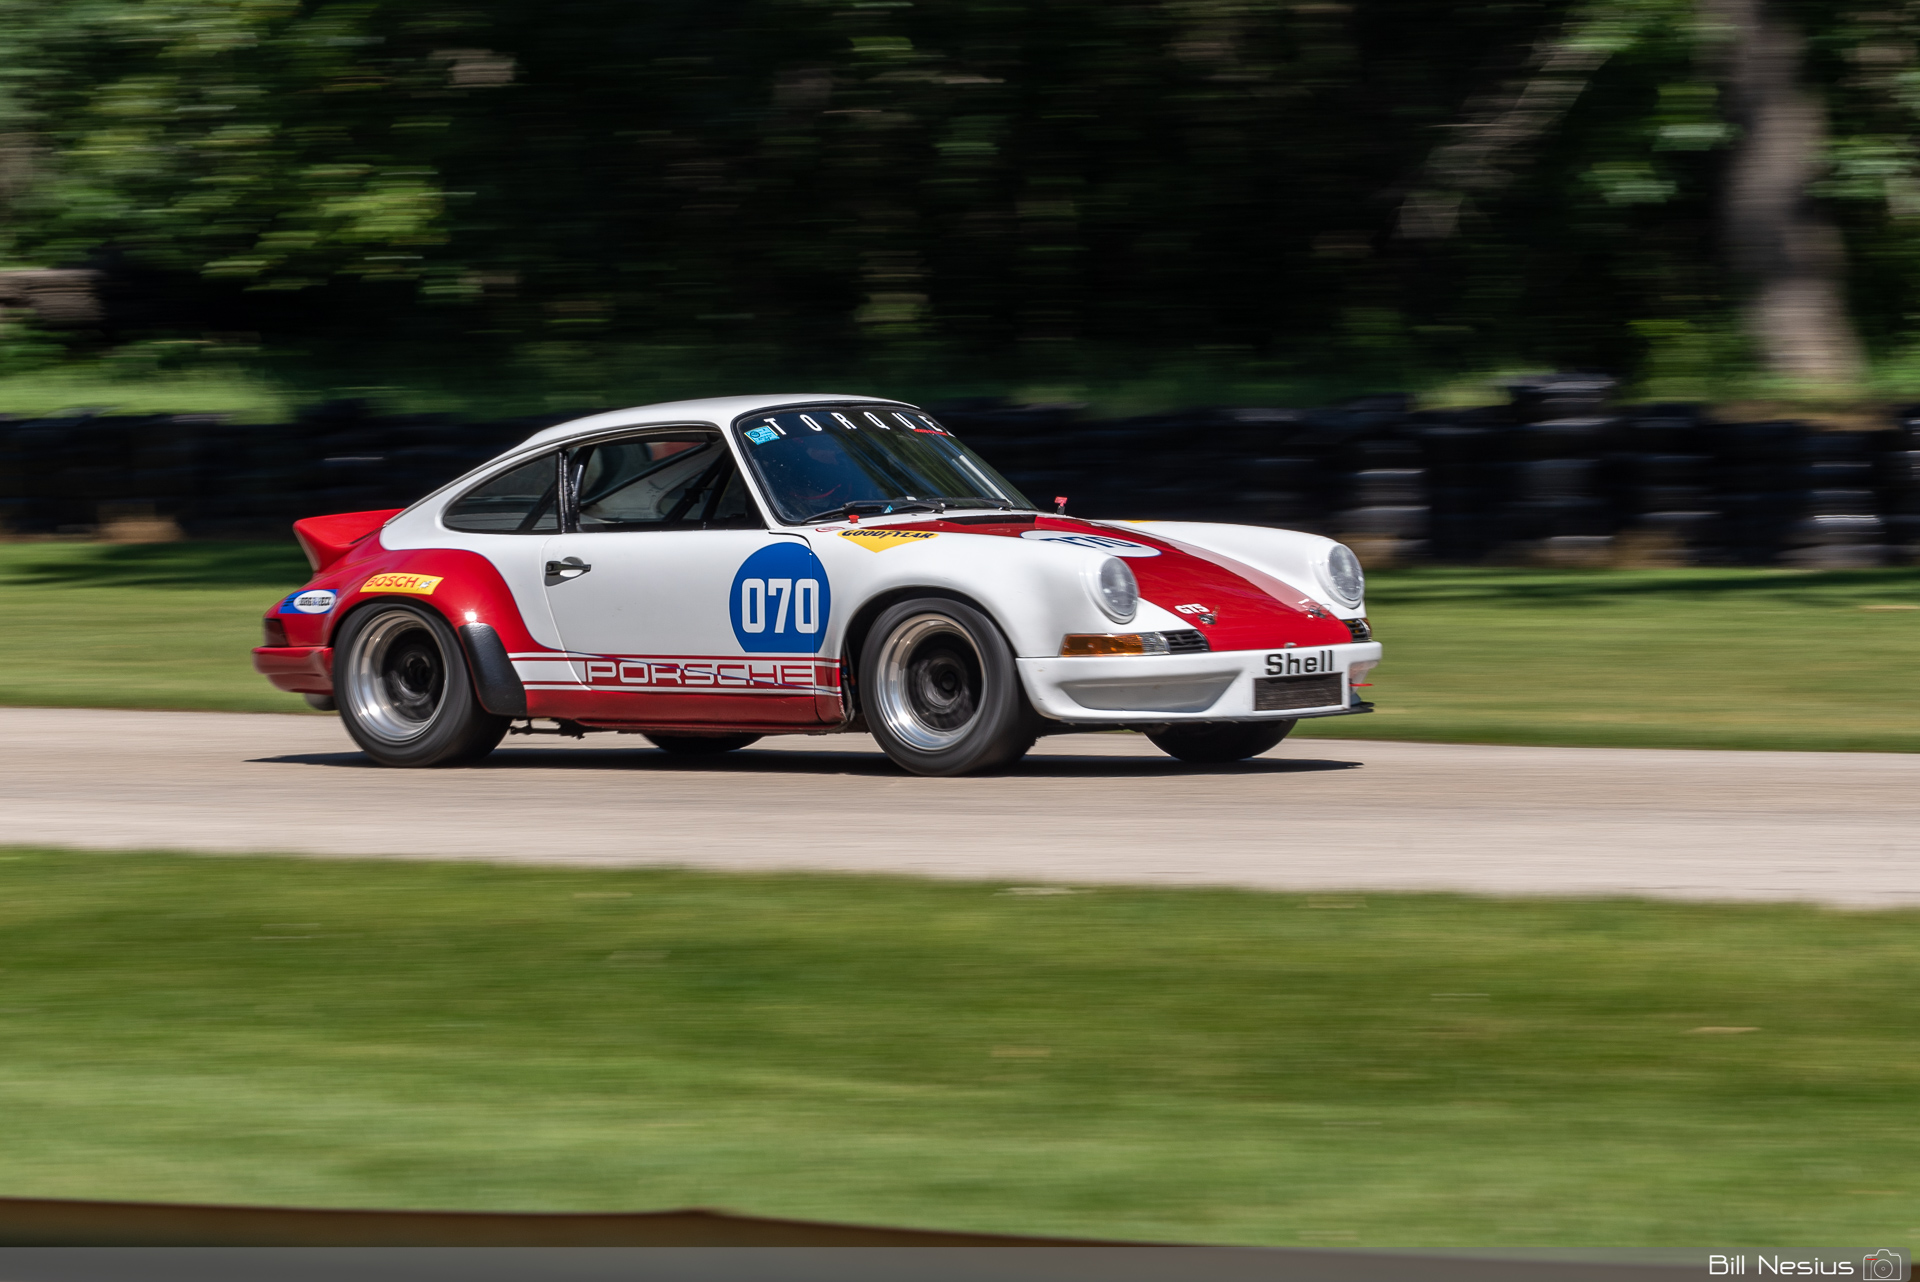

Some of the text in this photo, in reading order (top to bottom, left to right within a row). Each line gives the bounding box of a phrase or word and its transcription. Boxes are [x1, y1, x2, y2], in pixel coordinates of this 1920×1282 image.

[841, 529, 935, 539] GOODYEAR
[365, 575, 420, 588] BOSCH
[741, 577, 820, 634] 070
[586, 660, 813, 686] PORSCHE
[1265, 649, 1334, 676] Shell
